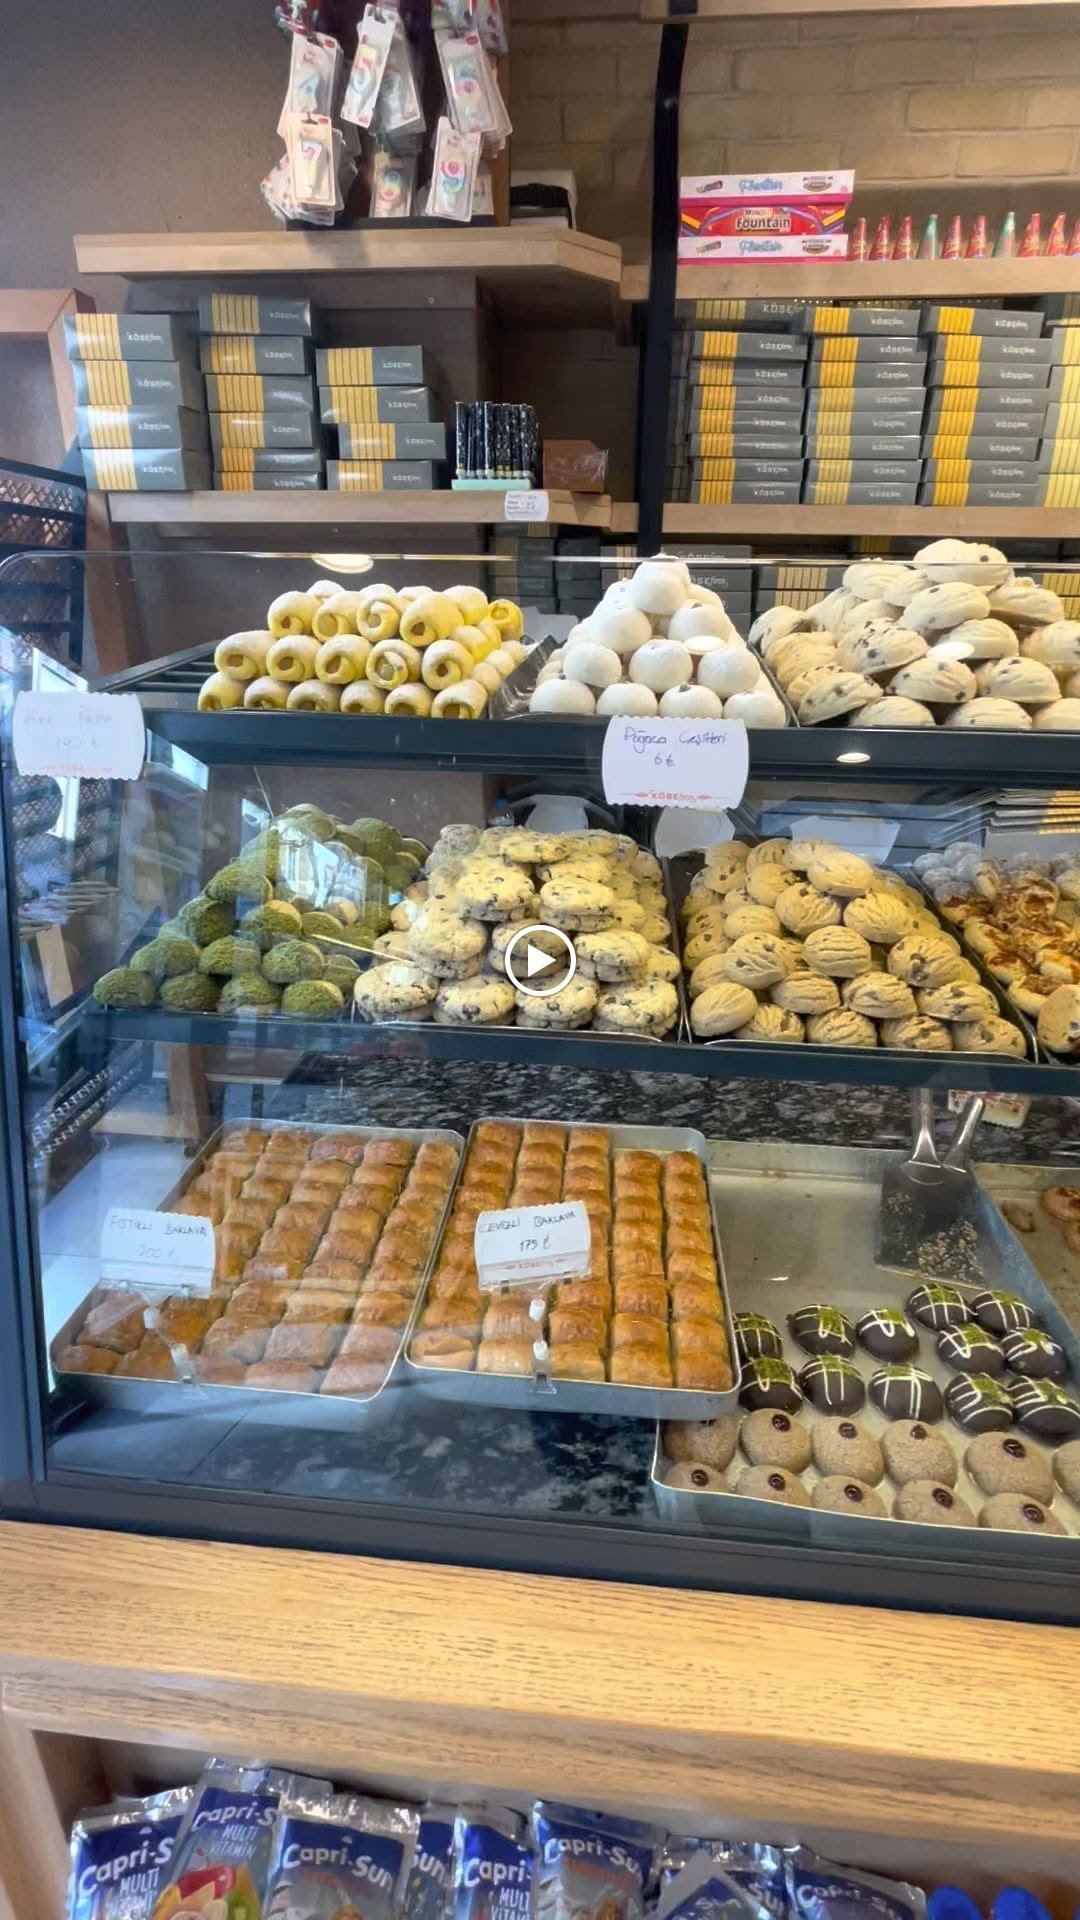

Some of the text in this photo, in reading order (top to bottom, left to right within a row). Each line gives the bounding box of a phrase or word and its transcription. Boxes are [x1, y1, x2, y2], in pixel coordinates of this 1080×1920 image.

[735, 217, 791, 231] Fountain
[190, 1801, 276, 1833] Capri-S
[222, 1823, 260, 1841] MULTI
[79, 1837, 175, 1897] Capri-S
[120, 1867, 160, 1896] MULTI
[282, 1843, 395, 1894] Capri-Sun
[463, 1857, 533, 1888] Capri-
[499, 1887, 530, 1912] MULT
